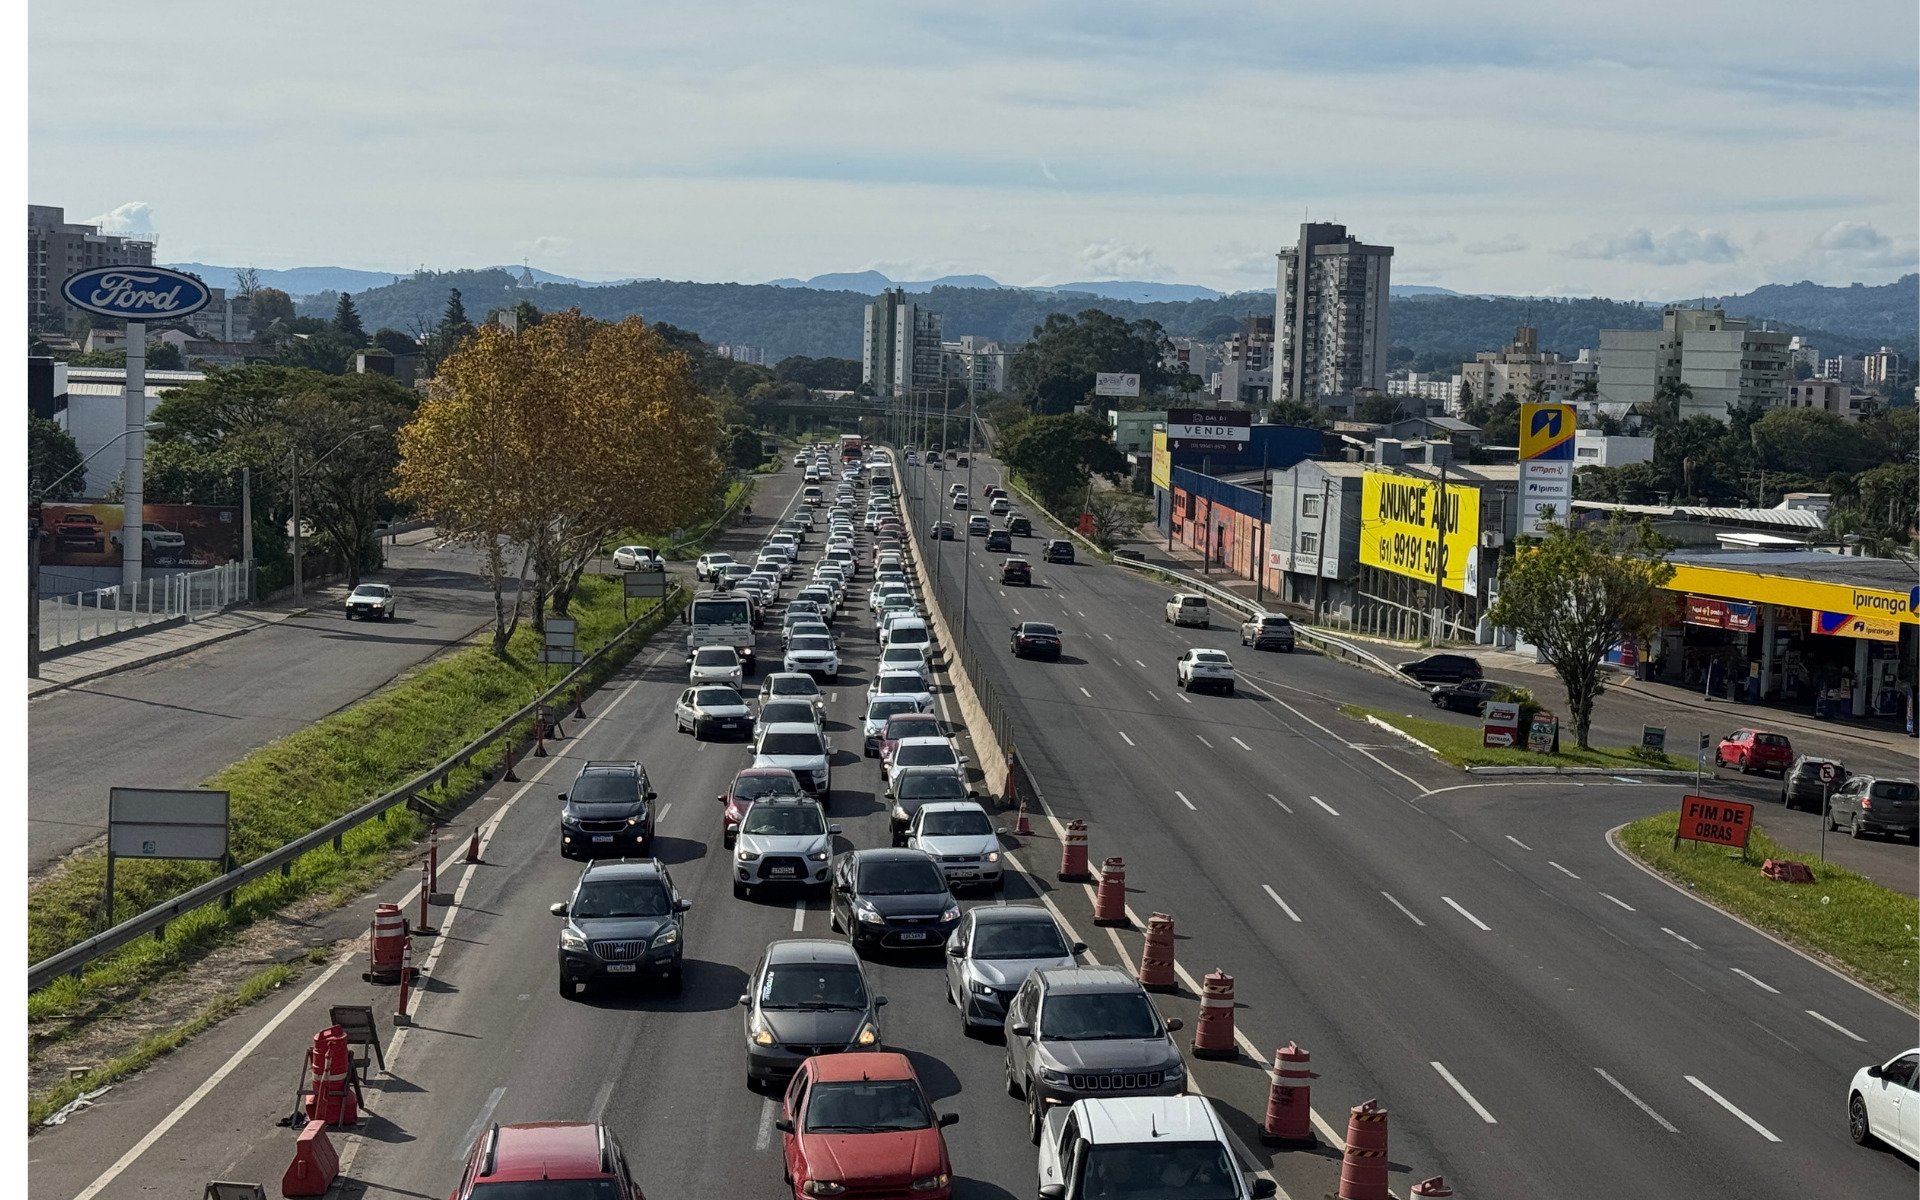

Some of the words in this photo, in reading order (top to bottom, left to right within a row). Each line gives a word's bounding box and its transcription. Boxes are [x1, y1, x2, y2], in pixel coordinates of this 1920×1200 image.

[91, 273, 182, 310] Ford
[1184, 426, 1234, 436] VENDE
[1531, 465, 1556, 474] ampm
[1379, 482, 1427, 527] ANUNCIE
[1380, 536, 1391, 566] (51)
[1394, 532, 1422, 571] 99191
[1424, 540, 1449, 578] 502
[1852, 590, 1907, 615] Ipiranga
[1866, 627, 1894, 636] Ipiranga
[1689, 803, 1718, 821] FIM
[1722, 808, 1745, 825] DE
[1695, 822, 1733, 842] OBRAS
